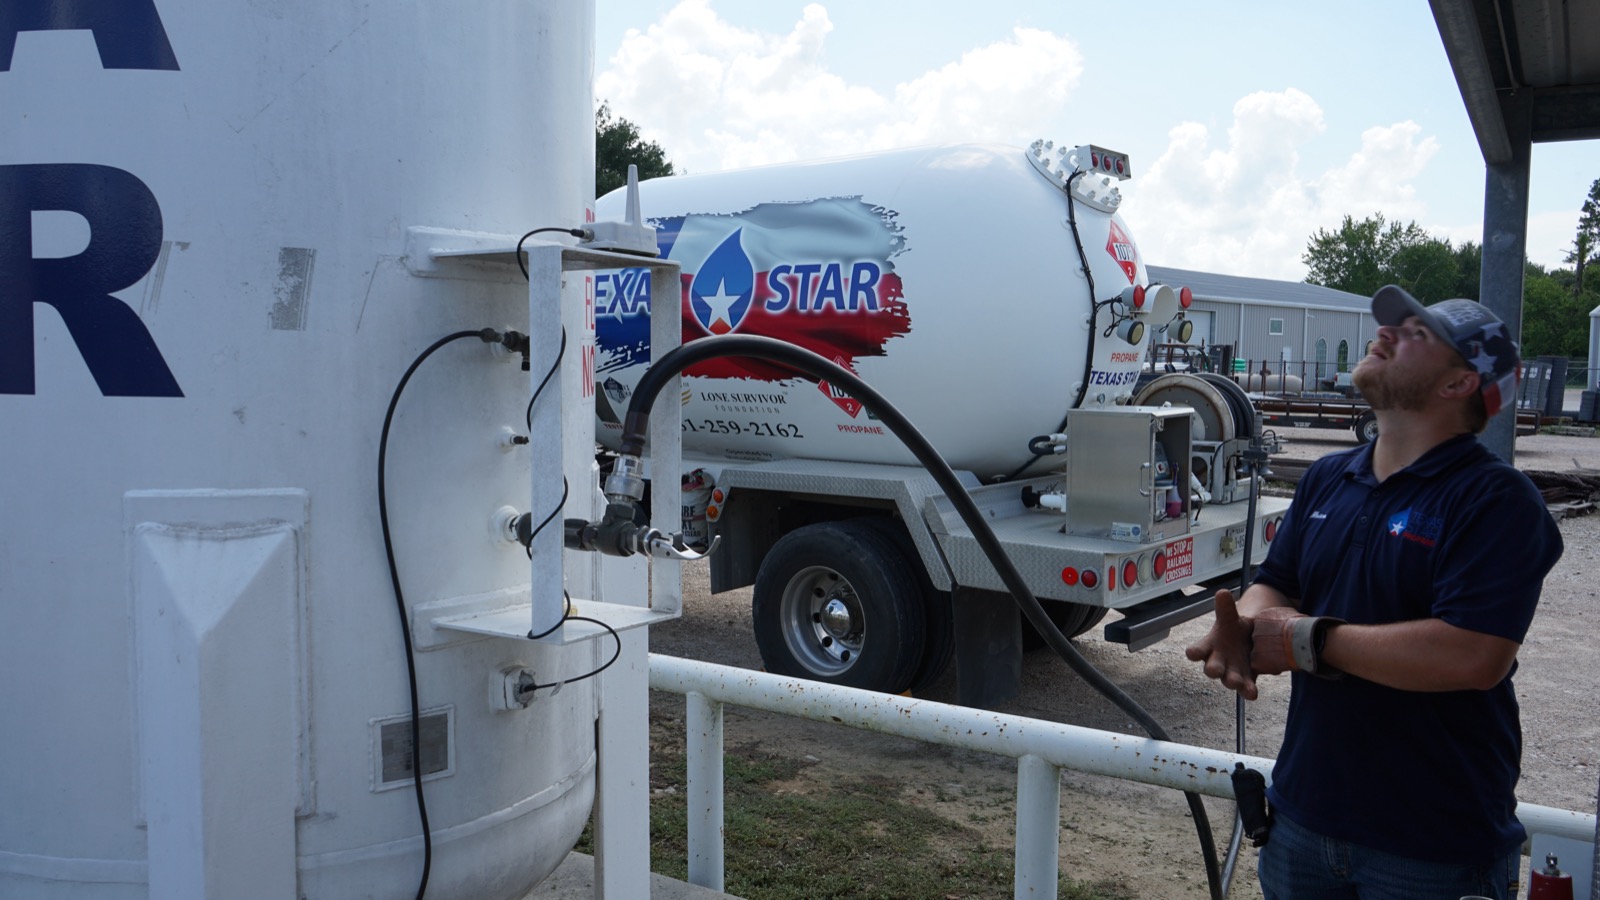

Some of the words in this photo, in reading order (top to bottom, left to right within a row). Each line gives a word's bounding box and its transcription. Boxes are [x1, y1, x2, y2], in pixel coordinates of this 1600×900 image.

[595, 272, 651, 314] EXA
[766, 262, 880, 311] STAR
[1110, 352, 1139, 363] PROPANE
[1090, 370, 1123, 386] TEXAS
[701, 391, 730, 402] LONE
[731, 393, 787, 404] SURVIVOR
[715, 405, 780, 414] FOUNDATION
[846, 402, 853, 411] 2
[681, 418, 804, 438] 1-259-2162
[837, 424, 884, 435] PROPANE
[681, 505, 696, 517] IRE
[1173, 540, 1187, 555] STOP
[1187, 541, 1193, 552] AT
[1166, 553, 1192, 570] RAILROAD
[1166, 564, 1192, 582] CROSSINGS
